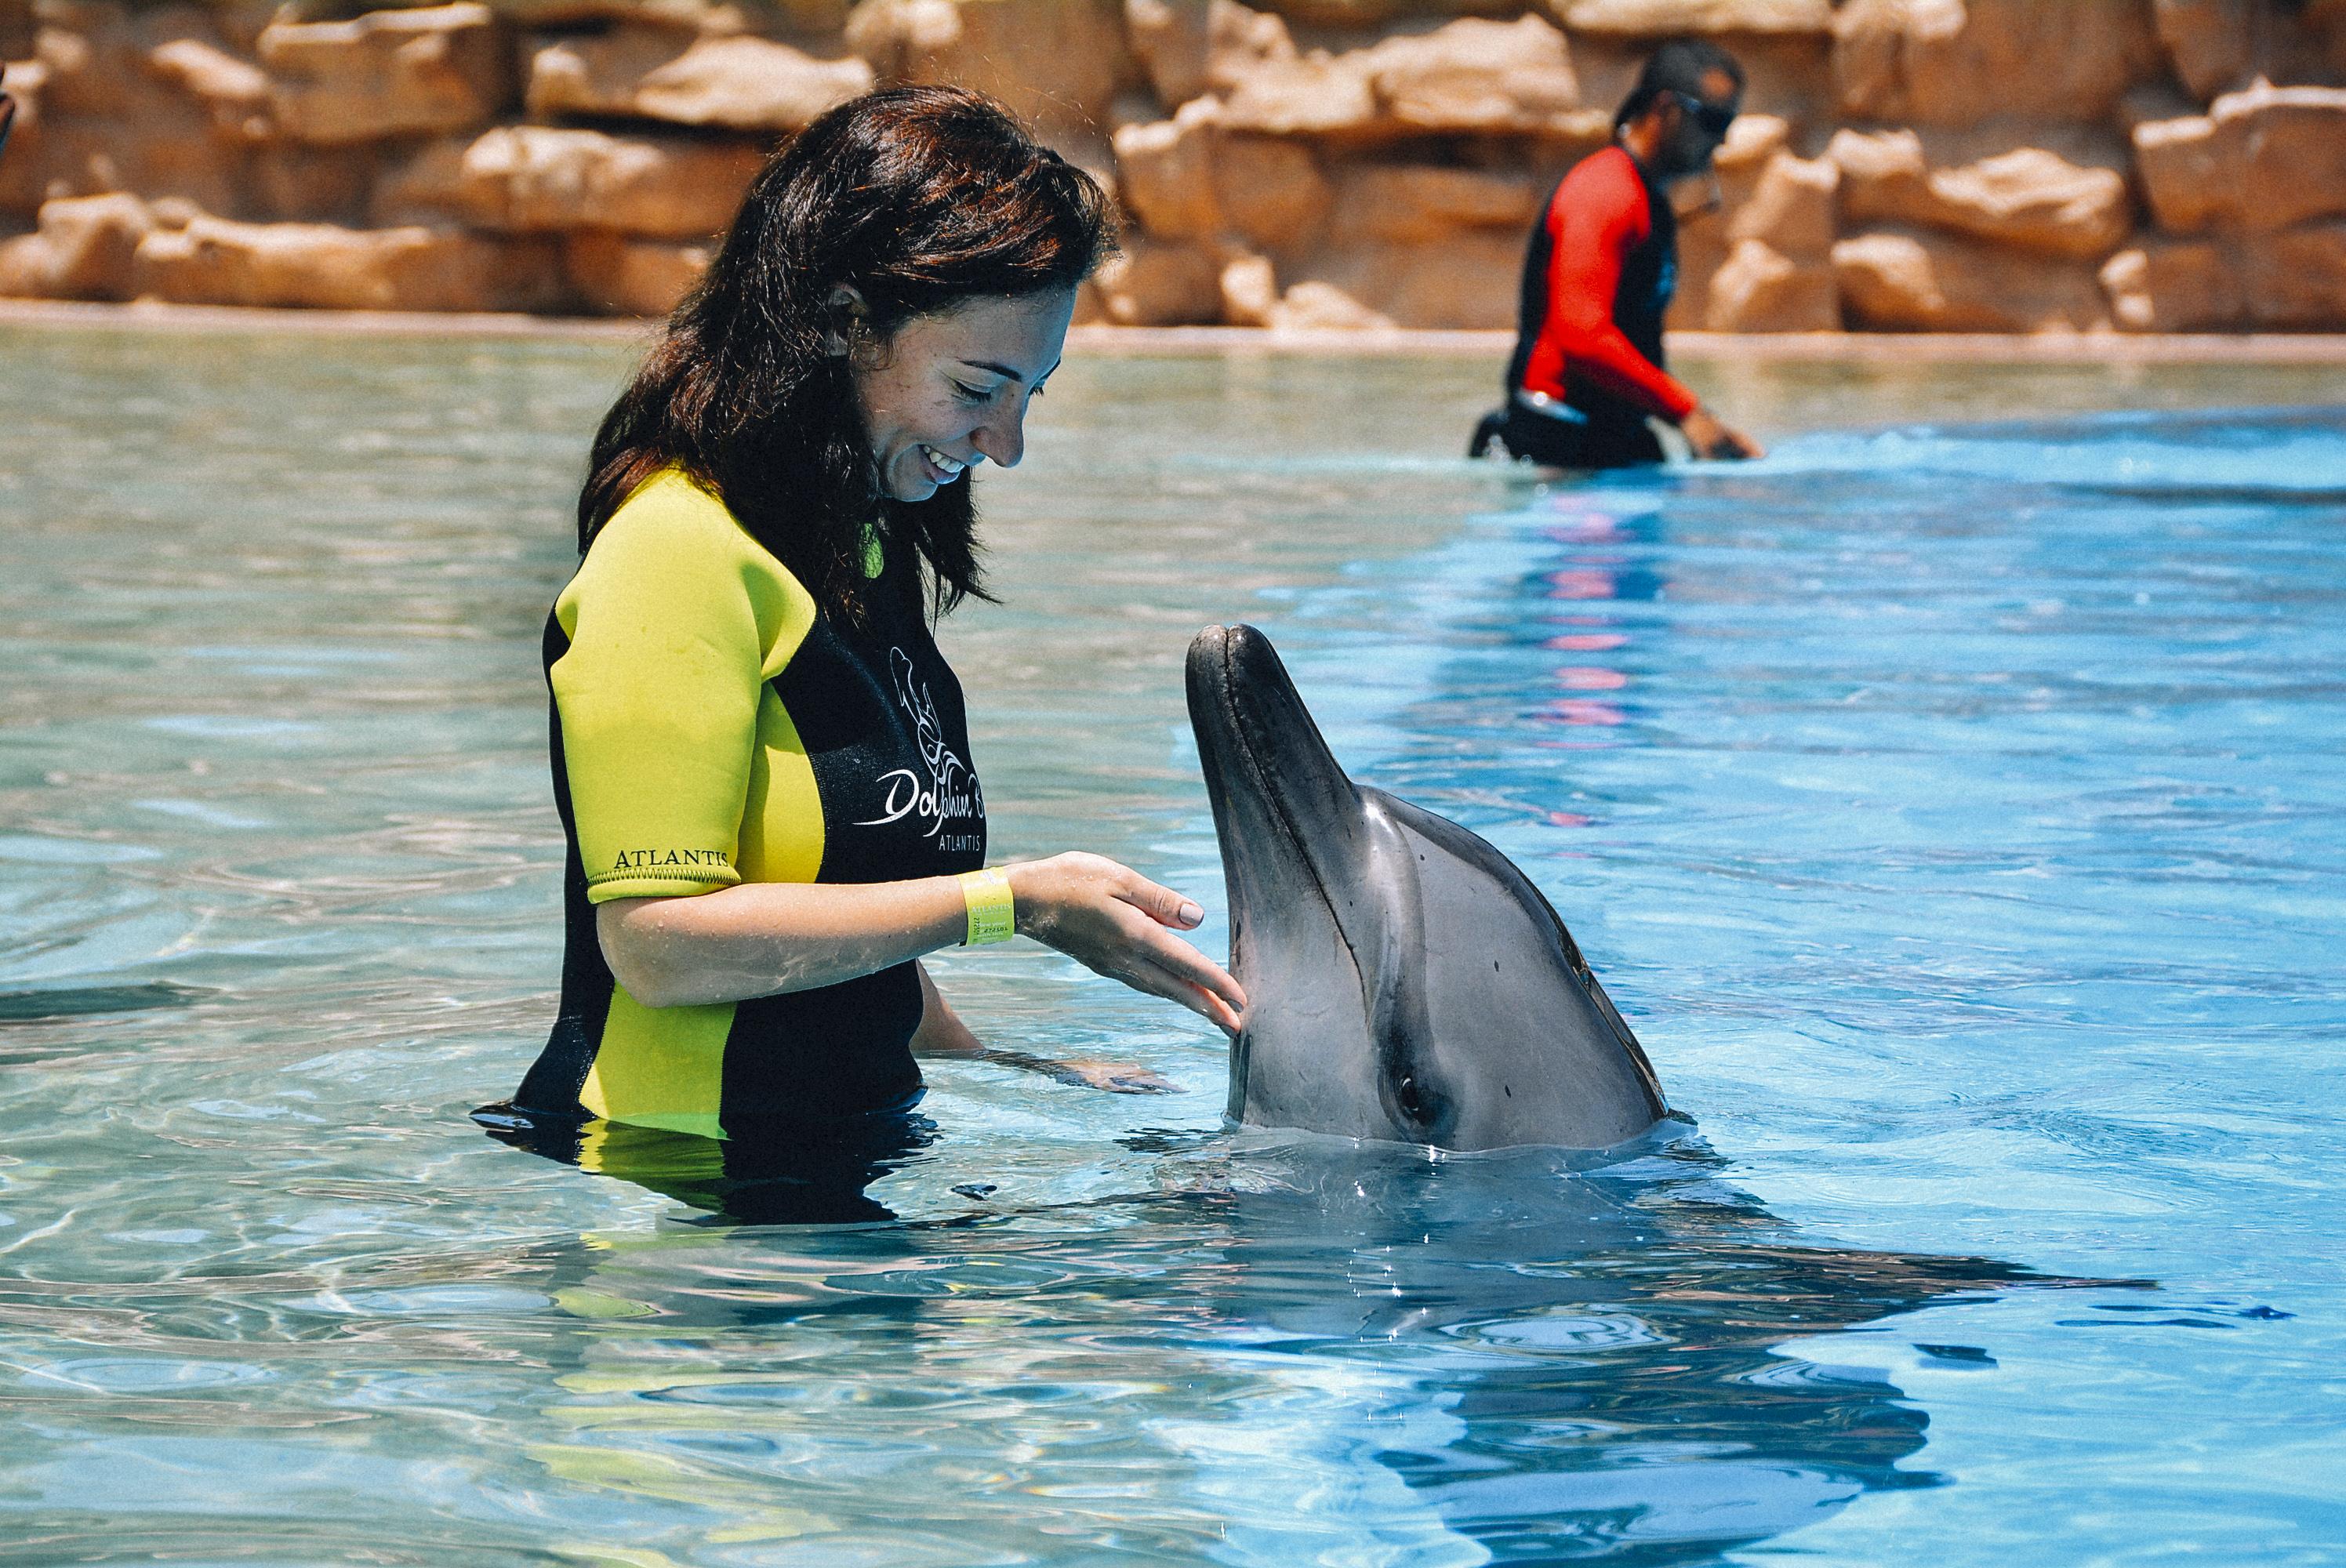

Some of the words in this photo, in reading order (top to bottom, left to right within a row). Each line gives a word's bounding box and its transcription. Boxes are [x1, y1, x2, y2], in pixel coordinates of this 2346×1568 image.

[852, 767, 972, 837] Dolphin
[939, 835, 980, 851] ATLANTIS
[613, 849, 729, 869] ATLANTIS
[971, 903, 1011, 913] ATLANTIS
